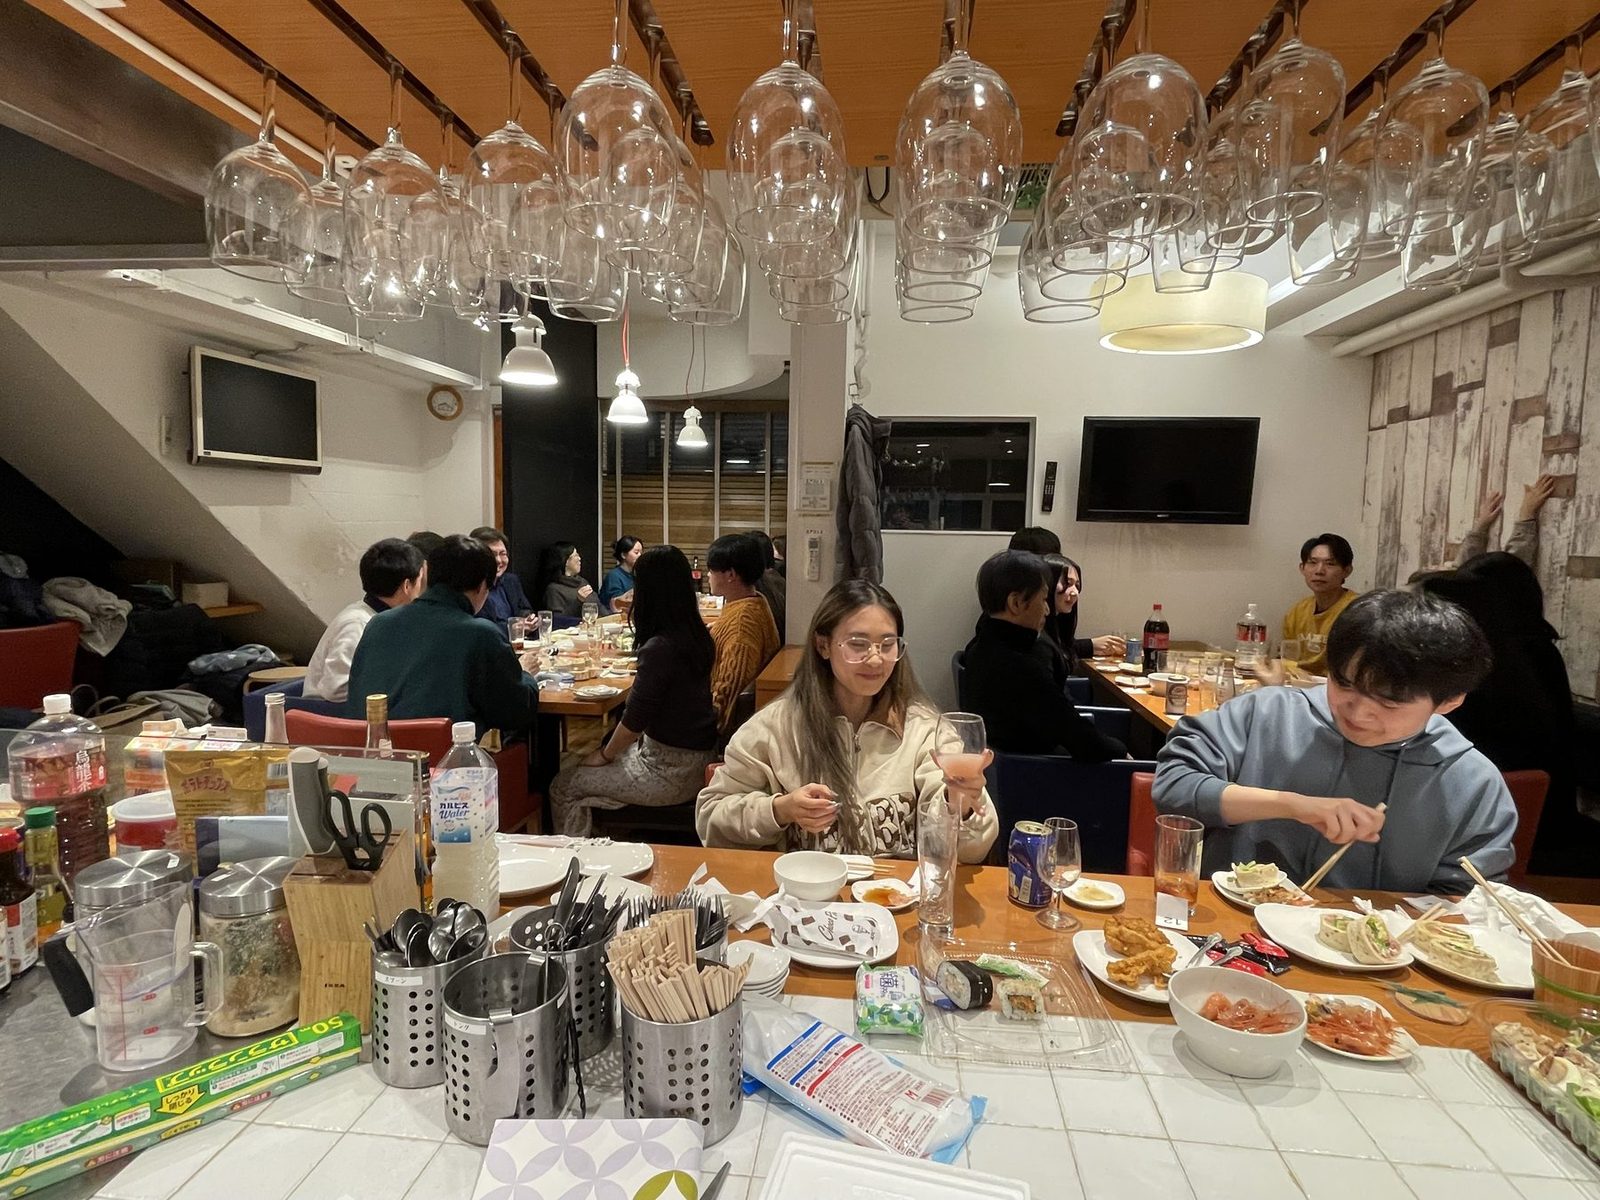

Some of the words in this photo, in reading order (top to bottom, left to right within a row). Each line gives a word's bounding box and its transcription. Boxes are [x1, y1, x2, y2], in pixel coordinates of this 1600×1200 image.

[439, 809, 470, 819] Water
[166, 1037, 290, 1087] サランラップ
[166, 1088, 195, 1104] しっかり
[168, 1098, 192, 1111] 閉じる
